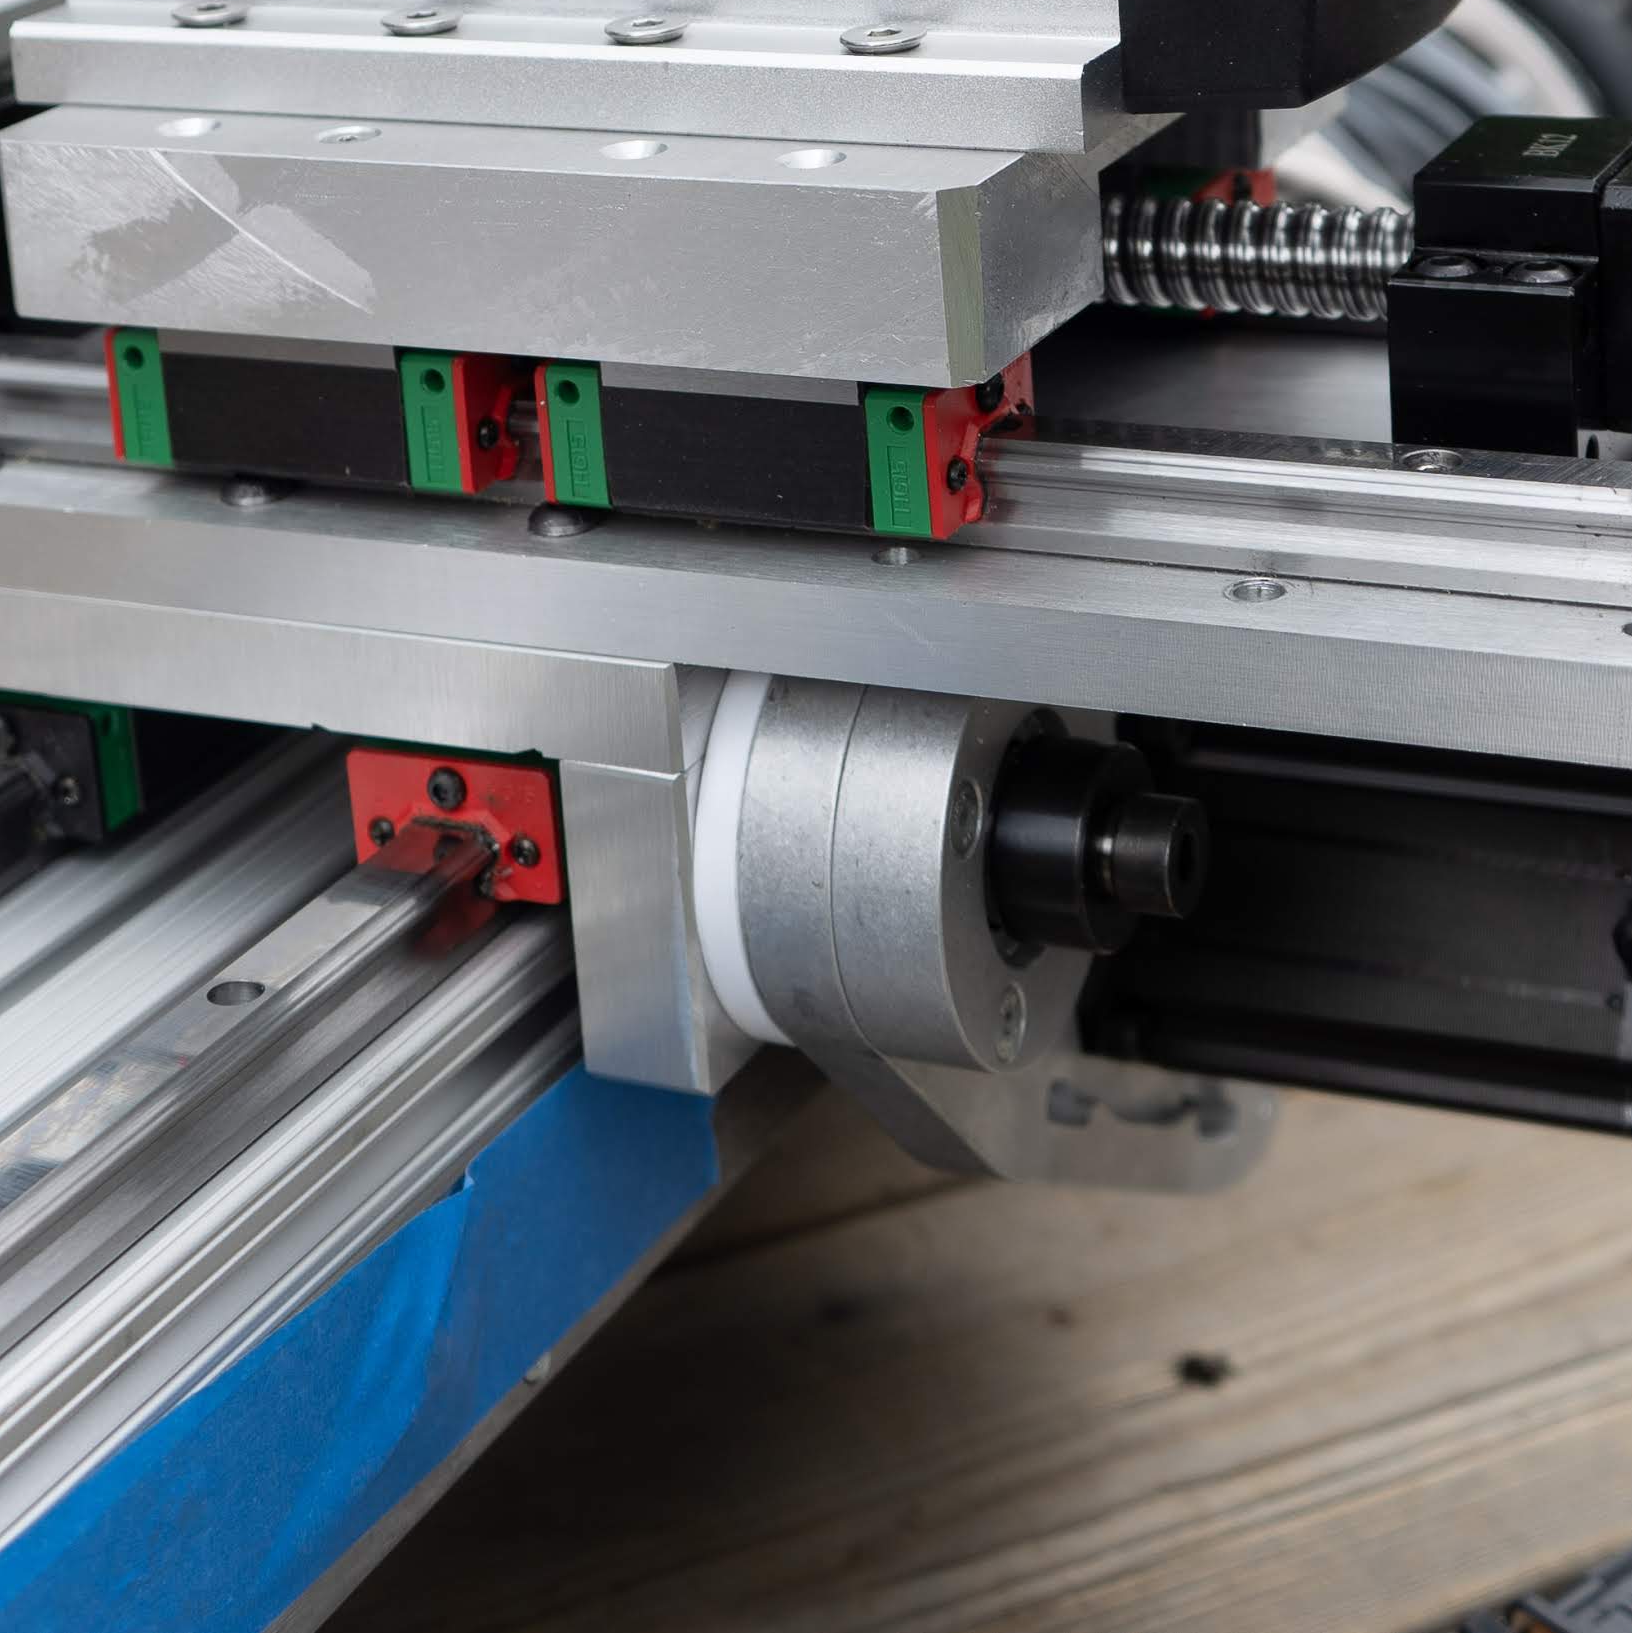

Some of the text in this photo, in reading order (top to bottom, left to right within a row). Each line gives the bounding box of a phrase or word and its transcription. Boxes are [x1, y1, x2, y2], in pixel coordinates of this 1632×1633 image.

[1522, 133, 1577, 158] BK12
[571, 434, 591, 488] HG15
[891, 460, 911, 513] HG15
